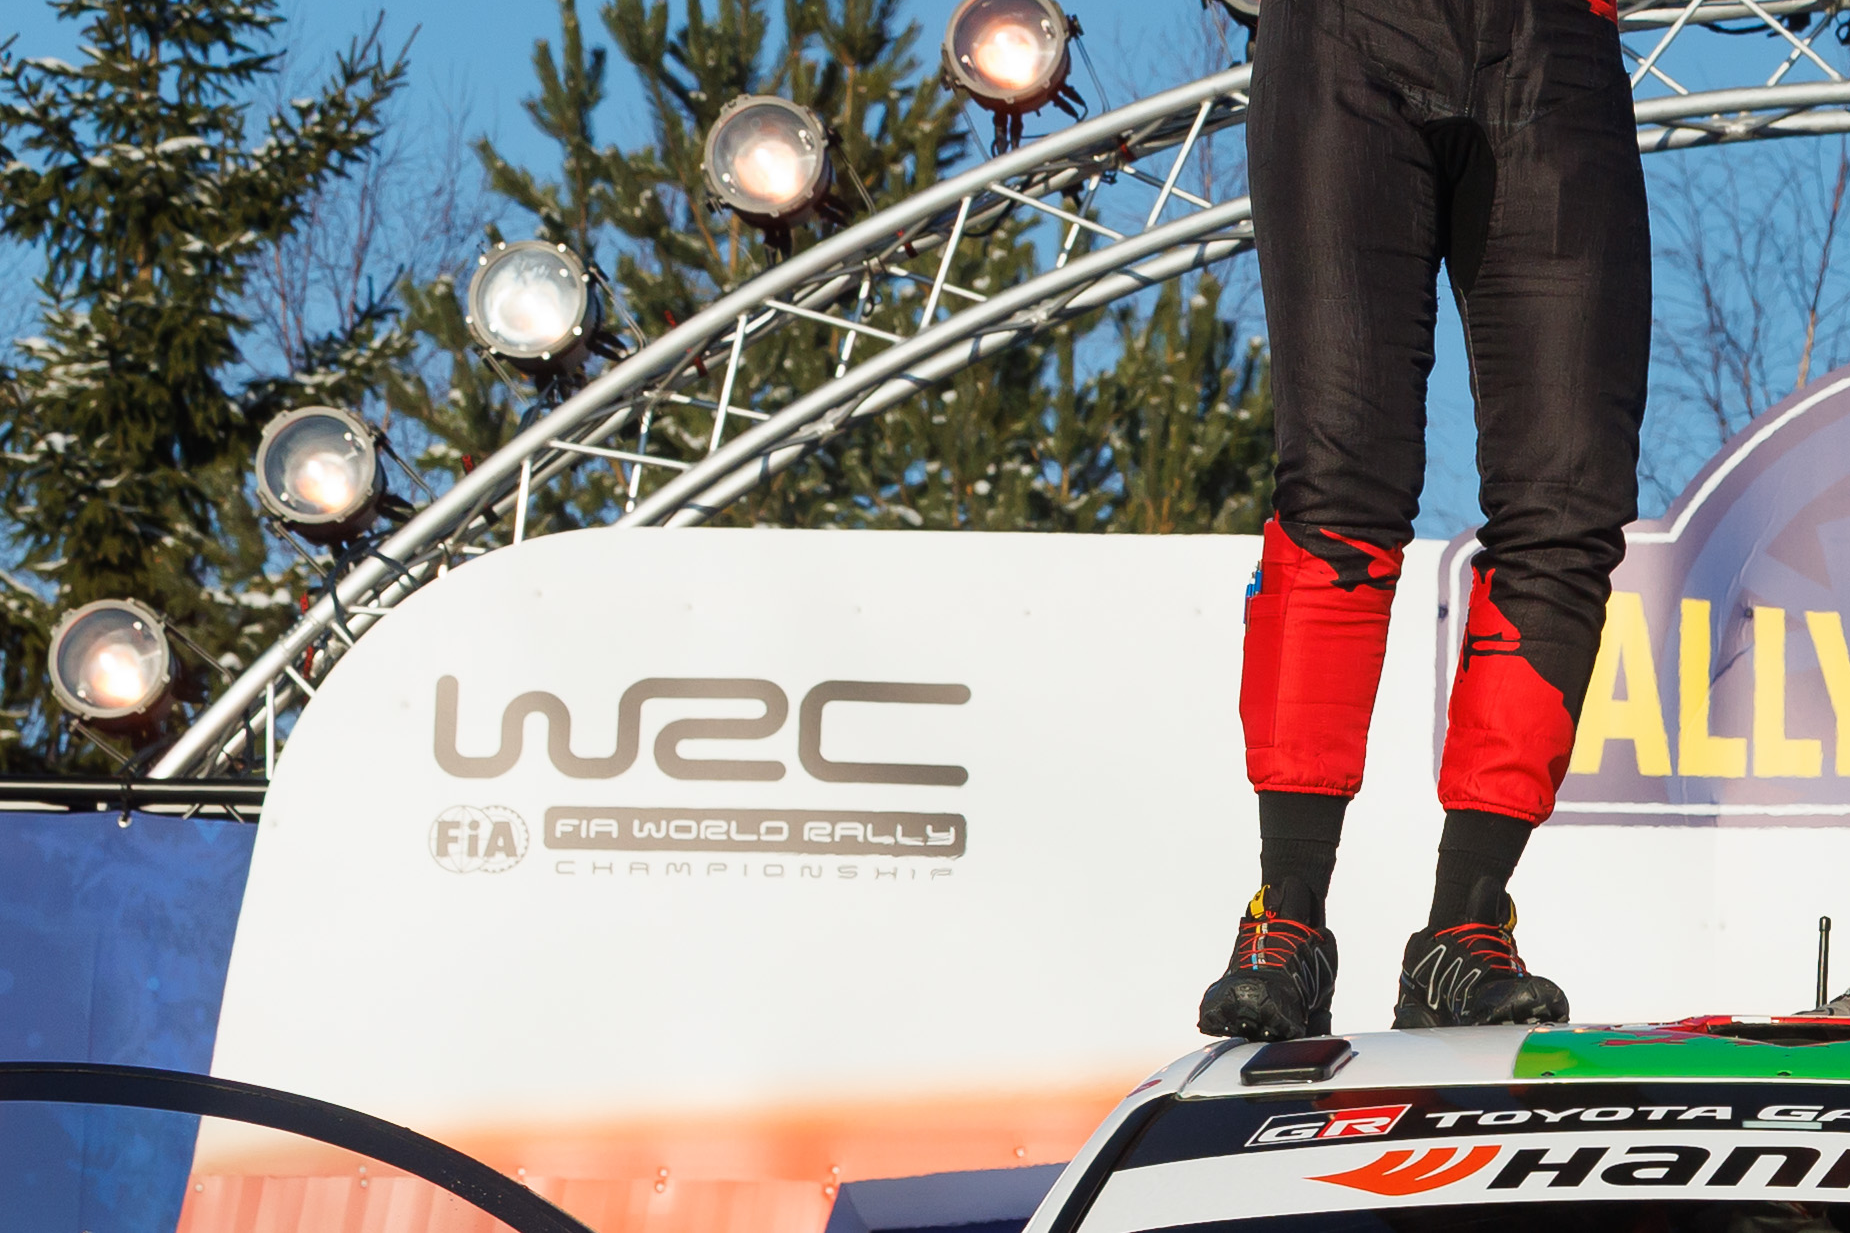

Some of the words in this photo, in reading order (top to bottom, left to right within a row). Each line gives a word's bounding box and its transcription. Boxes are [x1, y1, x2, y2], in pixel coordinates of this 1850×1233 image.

[434, 675, 971, 786] WRC
[555, 819, 618, 838] FIA
[633, 820, 789, 841] WORLD
[803, 821, 956, 846] RALLY
[555, 860, 953, 880] CHAMPIONSHIP
[1258, 1116, 1391, 1143] GR
[1426, 1106, 1732, 1128] TOYOTA
